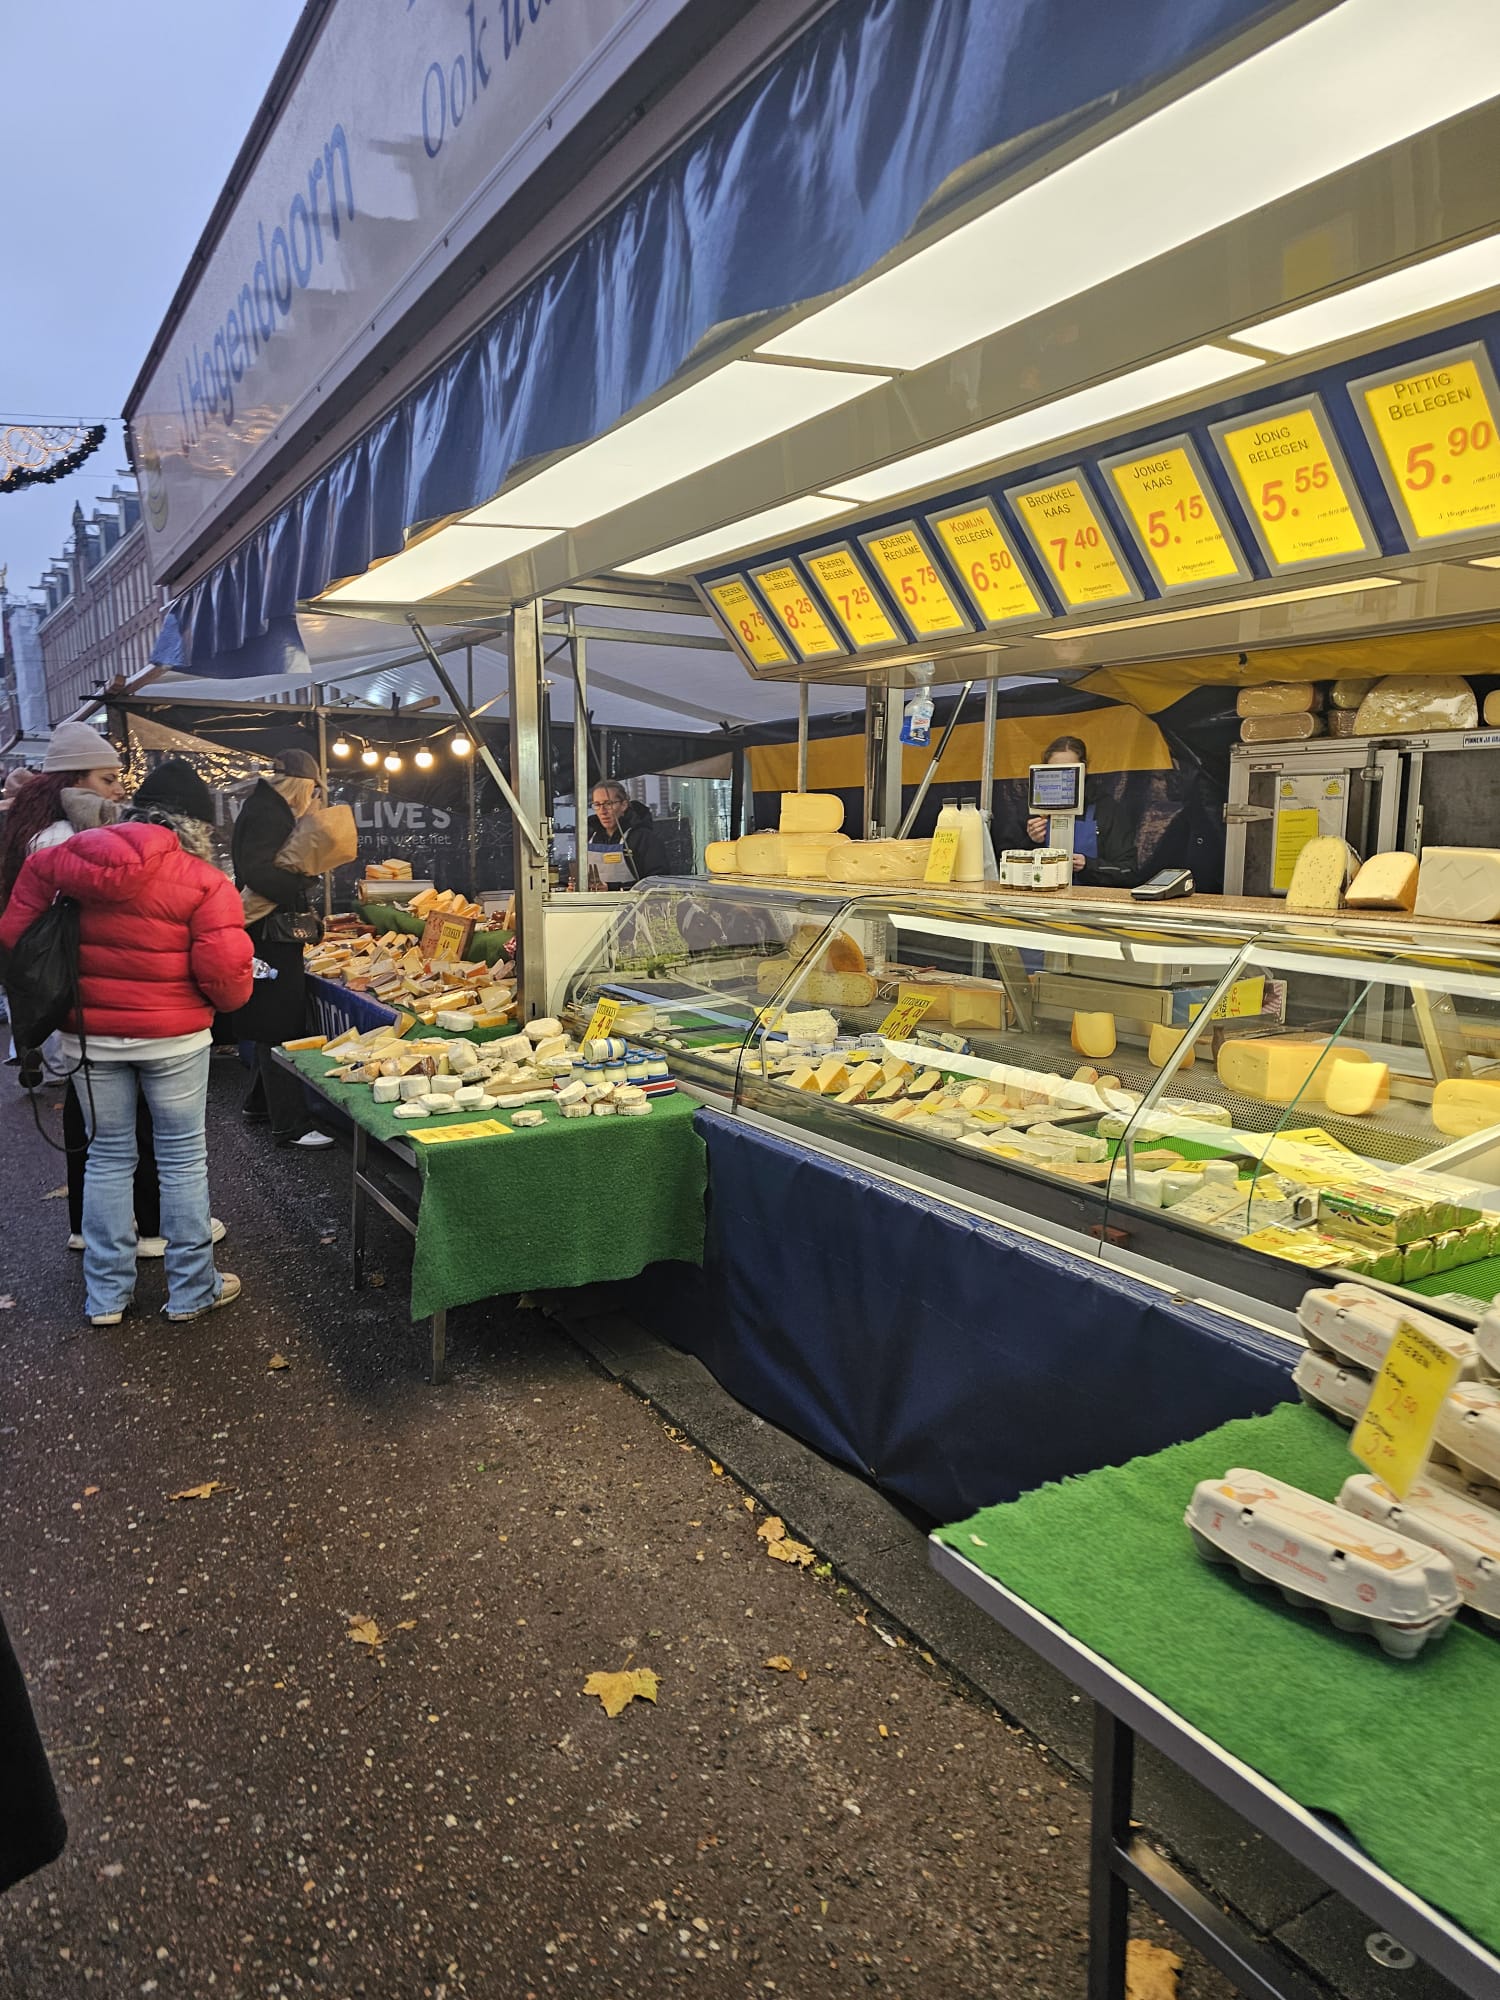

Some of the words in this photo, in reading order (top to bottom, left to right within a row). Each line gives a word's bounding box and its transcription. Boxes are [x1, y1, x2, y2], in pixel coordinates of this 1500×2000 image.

[422, 0, 491, 159] Ook
[183, 123, 355, 436] Hogendoorn
[1393, 372, 1452, 399] PITTIG
[1388, 387, 1473, 421] BELEGEN
[1253, 427, 1291, 446] JONG
[1248, 439, 1309, 465] BELEGEN
[1133, 459, 1172, 479] JONGE
[1142, 475, 1173, 492] KAAS
[1026, 488, 1075, 508] BROKKEL
[1043, 504, 1071, 519] KAAS
[949, 516, 985, 532] KOMIJN
[879, 534, 912, 550] BOEREN
[954, 528, 994, 545] BELEGEN
[883, 544, 920, 561] RECLAME
[816, 557, 845, 571] BOEREN
[821, 567, 854, 581] BELEGEN
